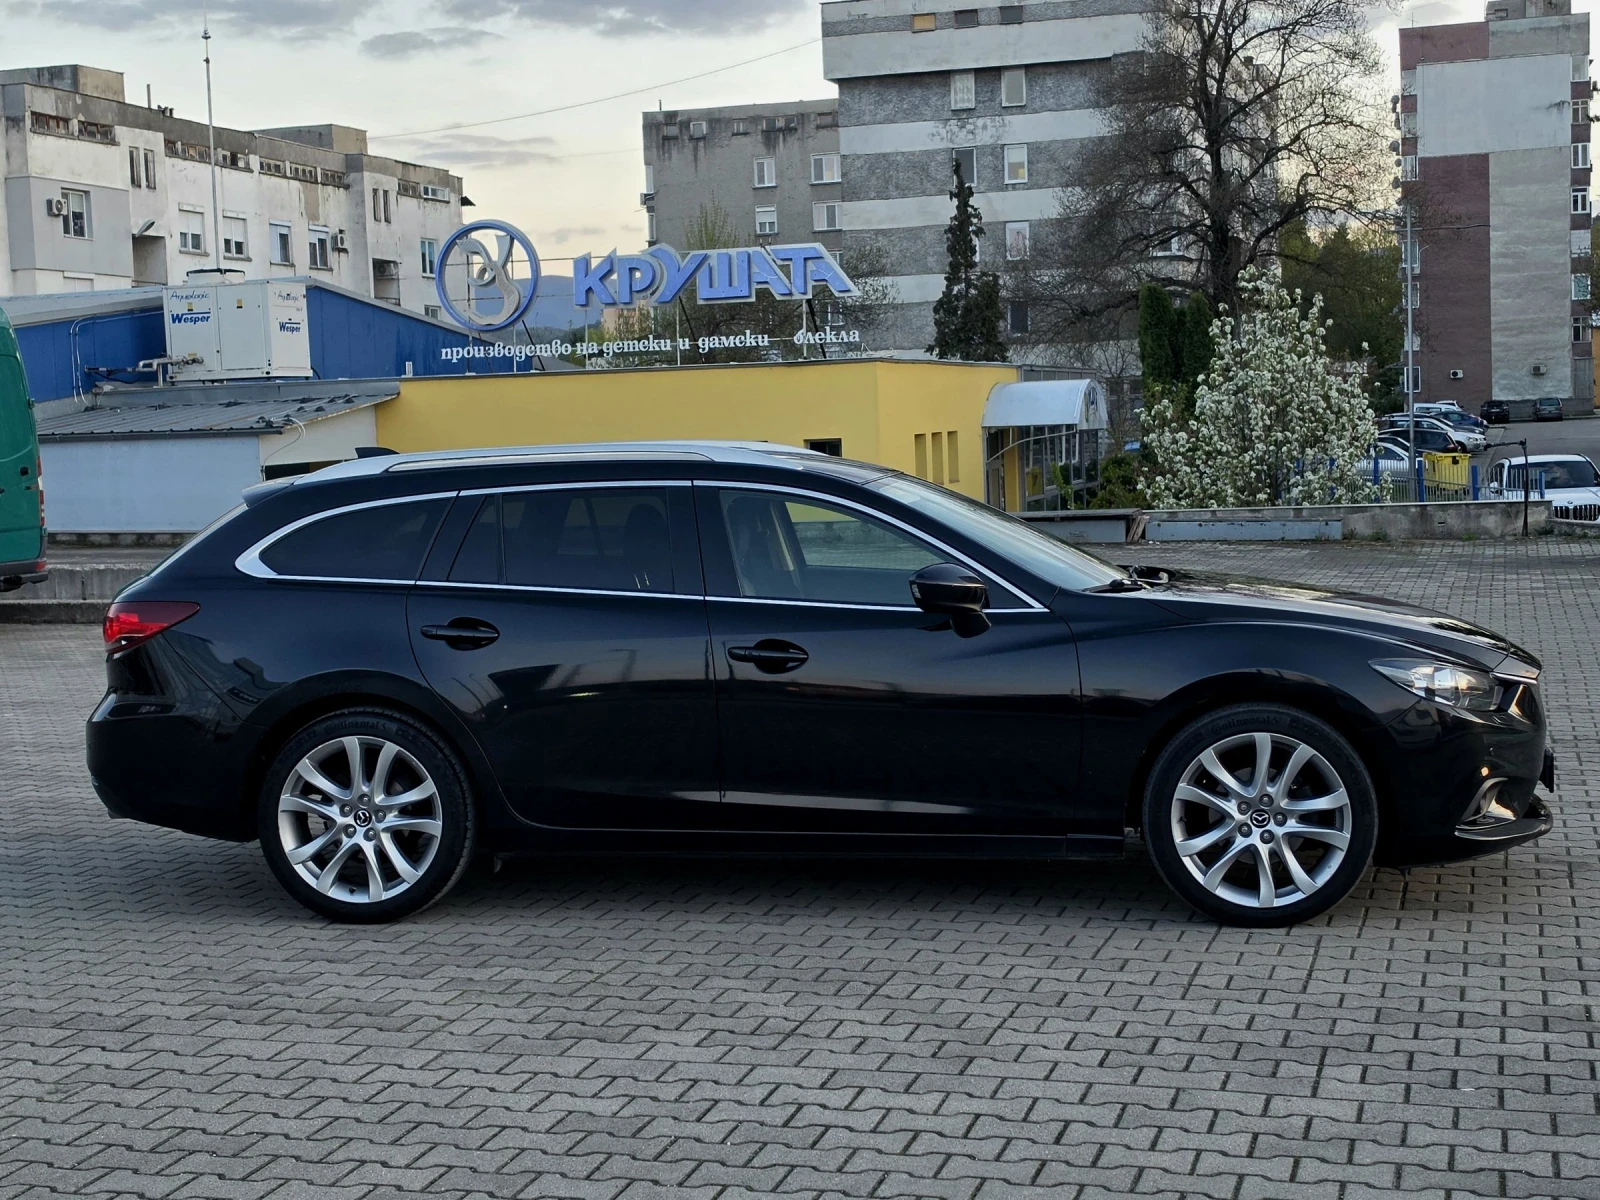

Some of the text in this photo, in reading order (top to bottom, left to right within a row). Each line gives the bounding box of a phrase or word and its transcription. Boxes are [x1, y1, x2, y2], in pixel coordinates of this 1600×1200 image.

[573, 243, 860, 309] КРУШАТА
[171, 312, 211, 325] Wesper
[279, 322, 301, 334] Wesper
[440, 339, 572, 362] производство
[575, 341, 599, 354] на
[603, 335, 672, 357] детски
[679, 336, 690, 350] и
[698, 330, 769, 354] дамски
